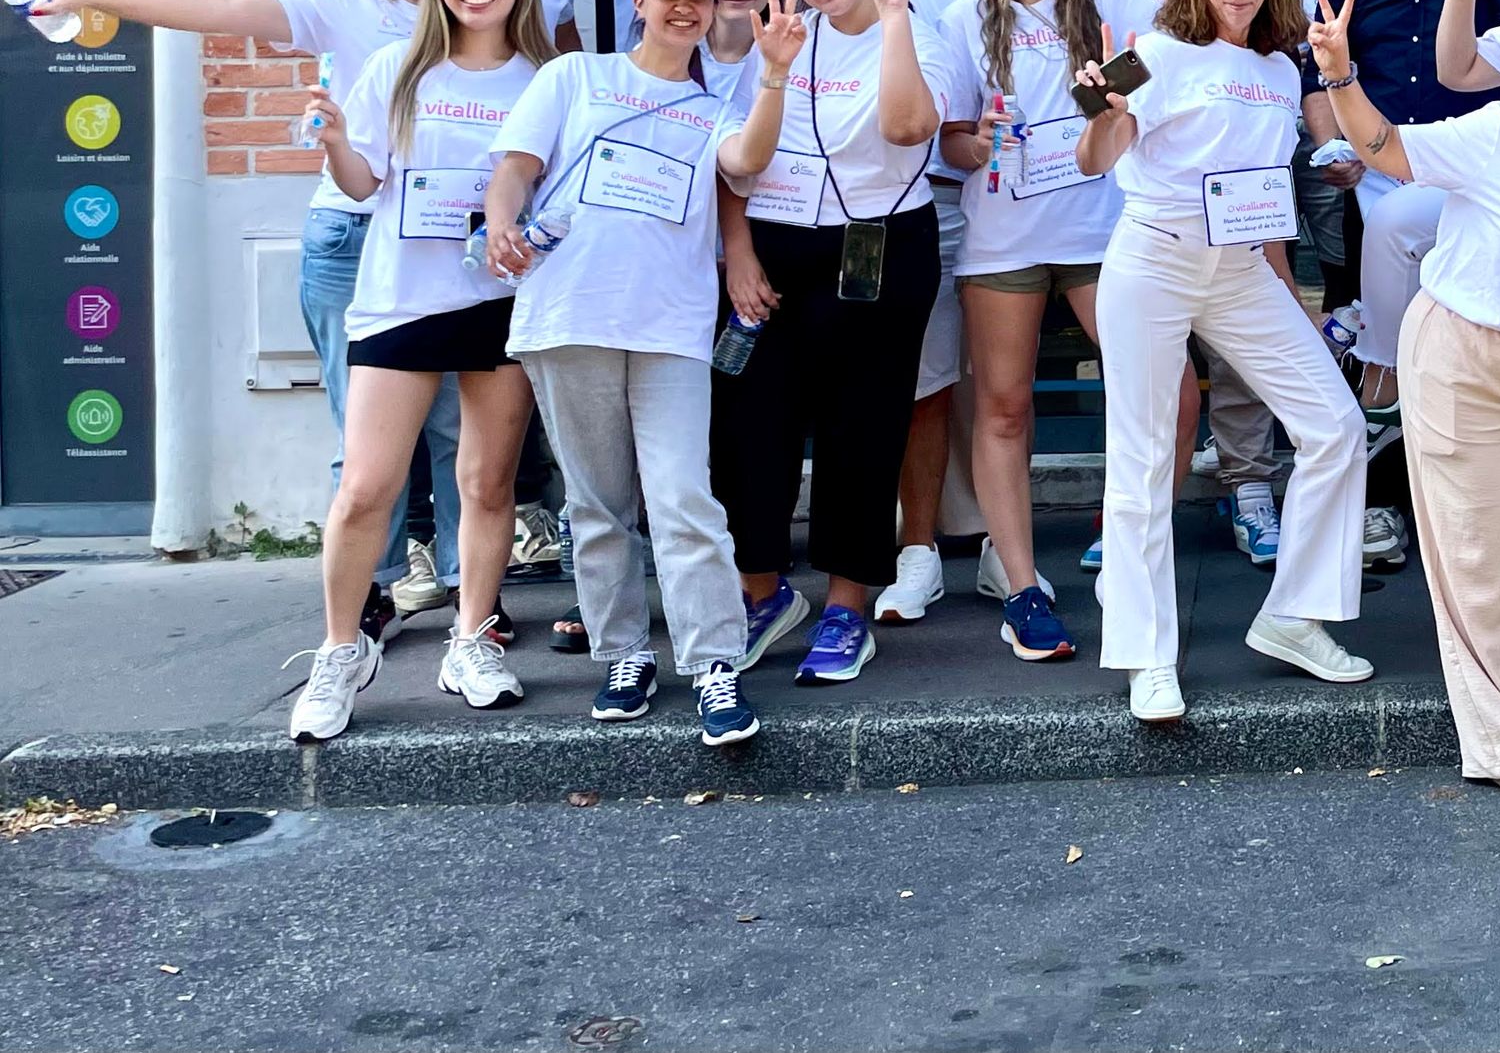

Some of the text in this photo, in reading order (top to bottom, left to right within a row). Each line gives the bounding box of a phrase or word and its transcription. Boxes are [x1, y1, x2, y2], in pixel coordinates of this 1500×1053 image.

[56, 53, 76, 61] Aide
[84, 52, 93, 61] la
[94, 52, 126, 61] toilette
[48, 65, 57, 73] et
[56, 154, 85, 162] Loisirs
[97, 153, 131, 162] évasion
[80, 243, 100, 252] Aide
[83, 345, 103, 353] Aide
